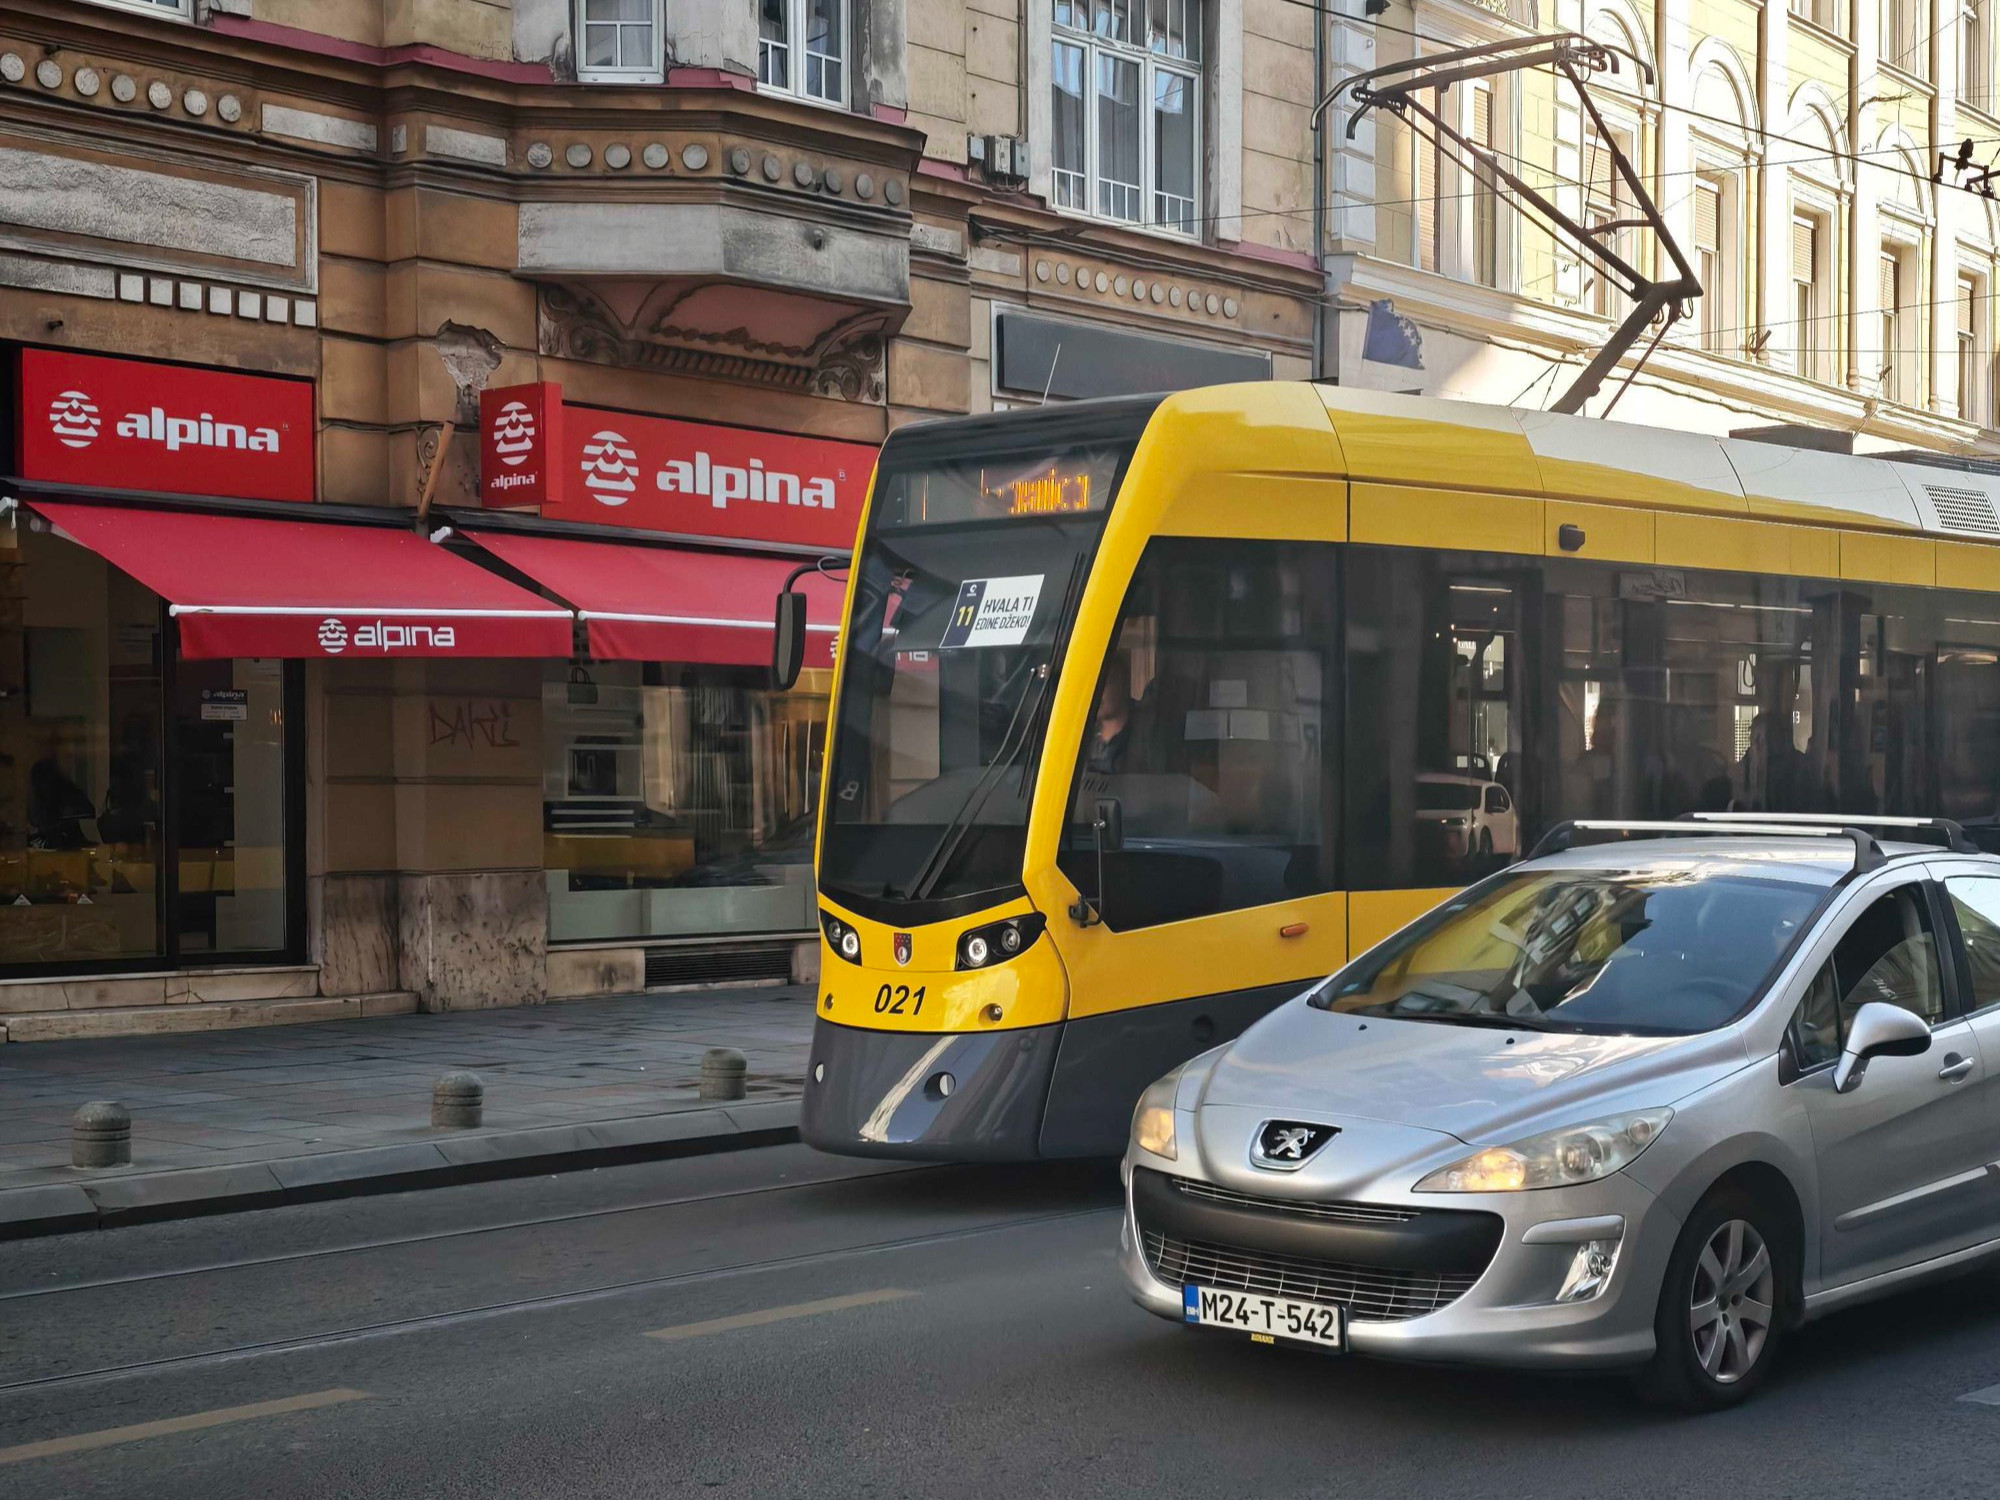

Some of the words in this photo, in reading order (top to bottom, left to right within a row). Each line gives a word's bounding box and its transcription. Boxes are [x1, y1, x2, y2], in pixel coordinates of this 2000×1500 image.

[117, 407, 279, 452] alpina
[490, 473, 535, 490] alpina
[656, 451, 836, 509] alpina
[956, 605, 974, 627] 11
[983, 597, 1020, 614] HVALA
[1023, 596, 1034, 611] TI
[354, 619, 456, 652] alpina
[975, 617, 1000, 631] EDINE
[874, 983, 926, 1016] 021
[1201, 1291, 1335, 1340] M24-T-542
